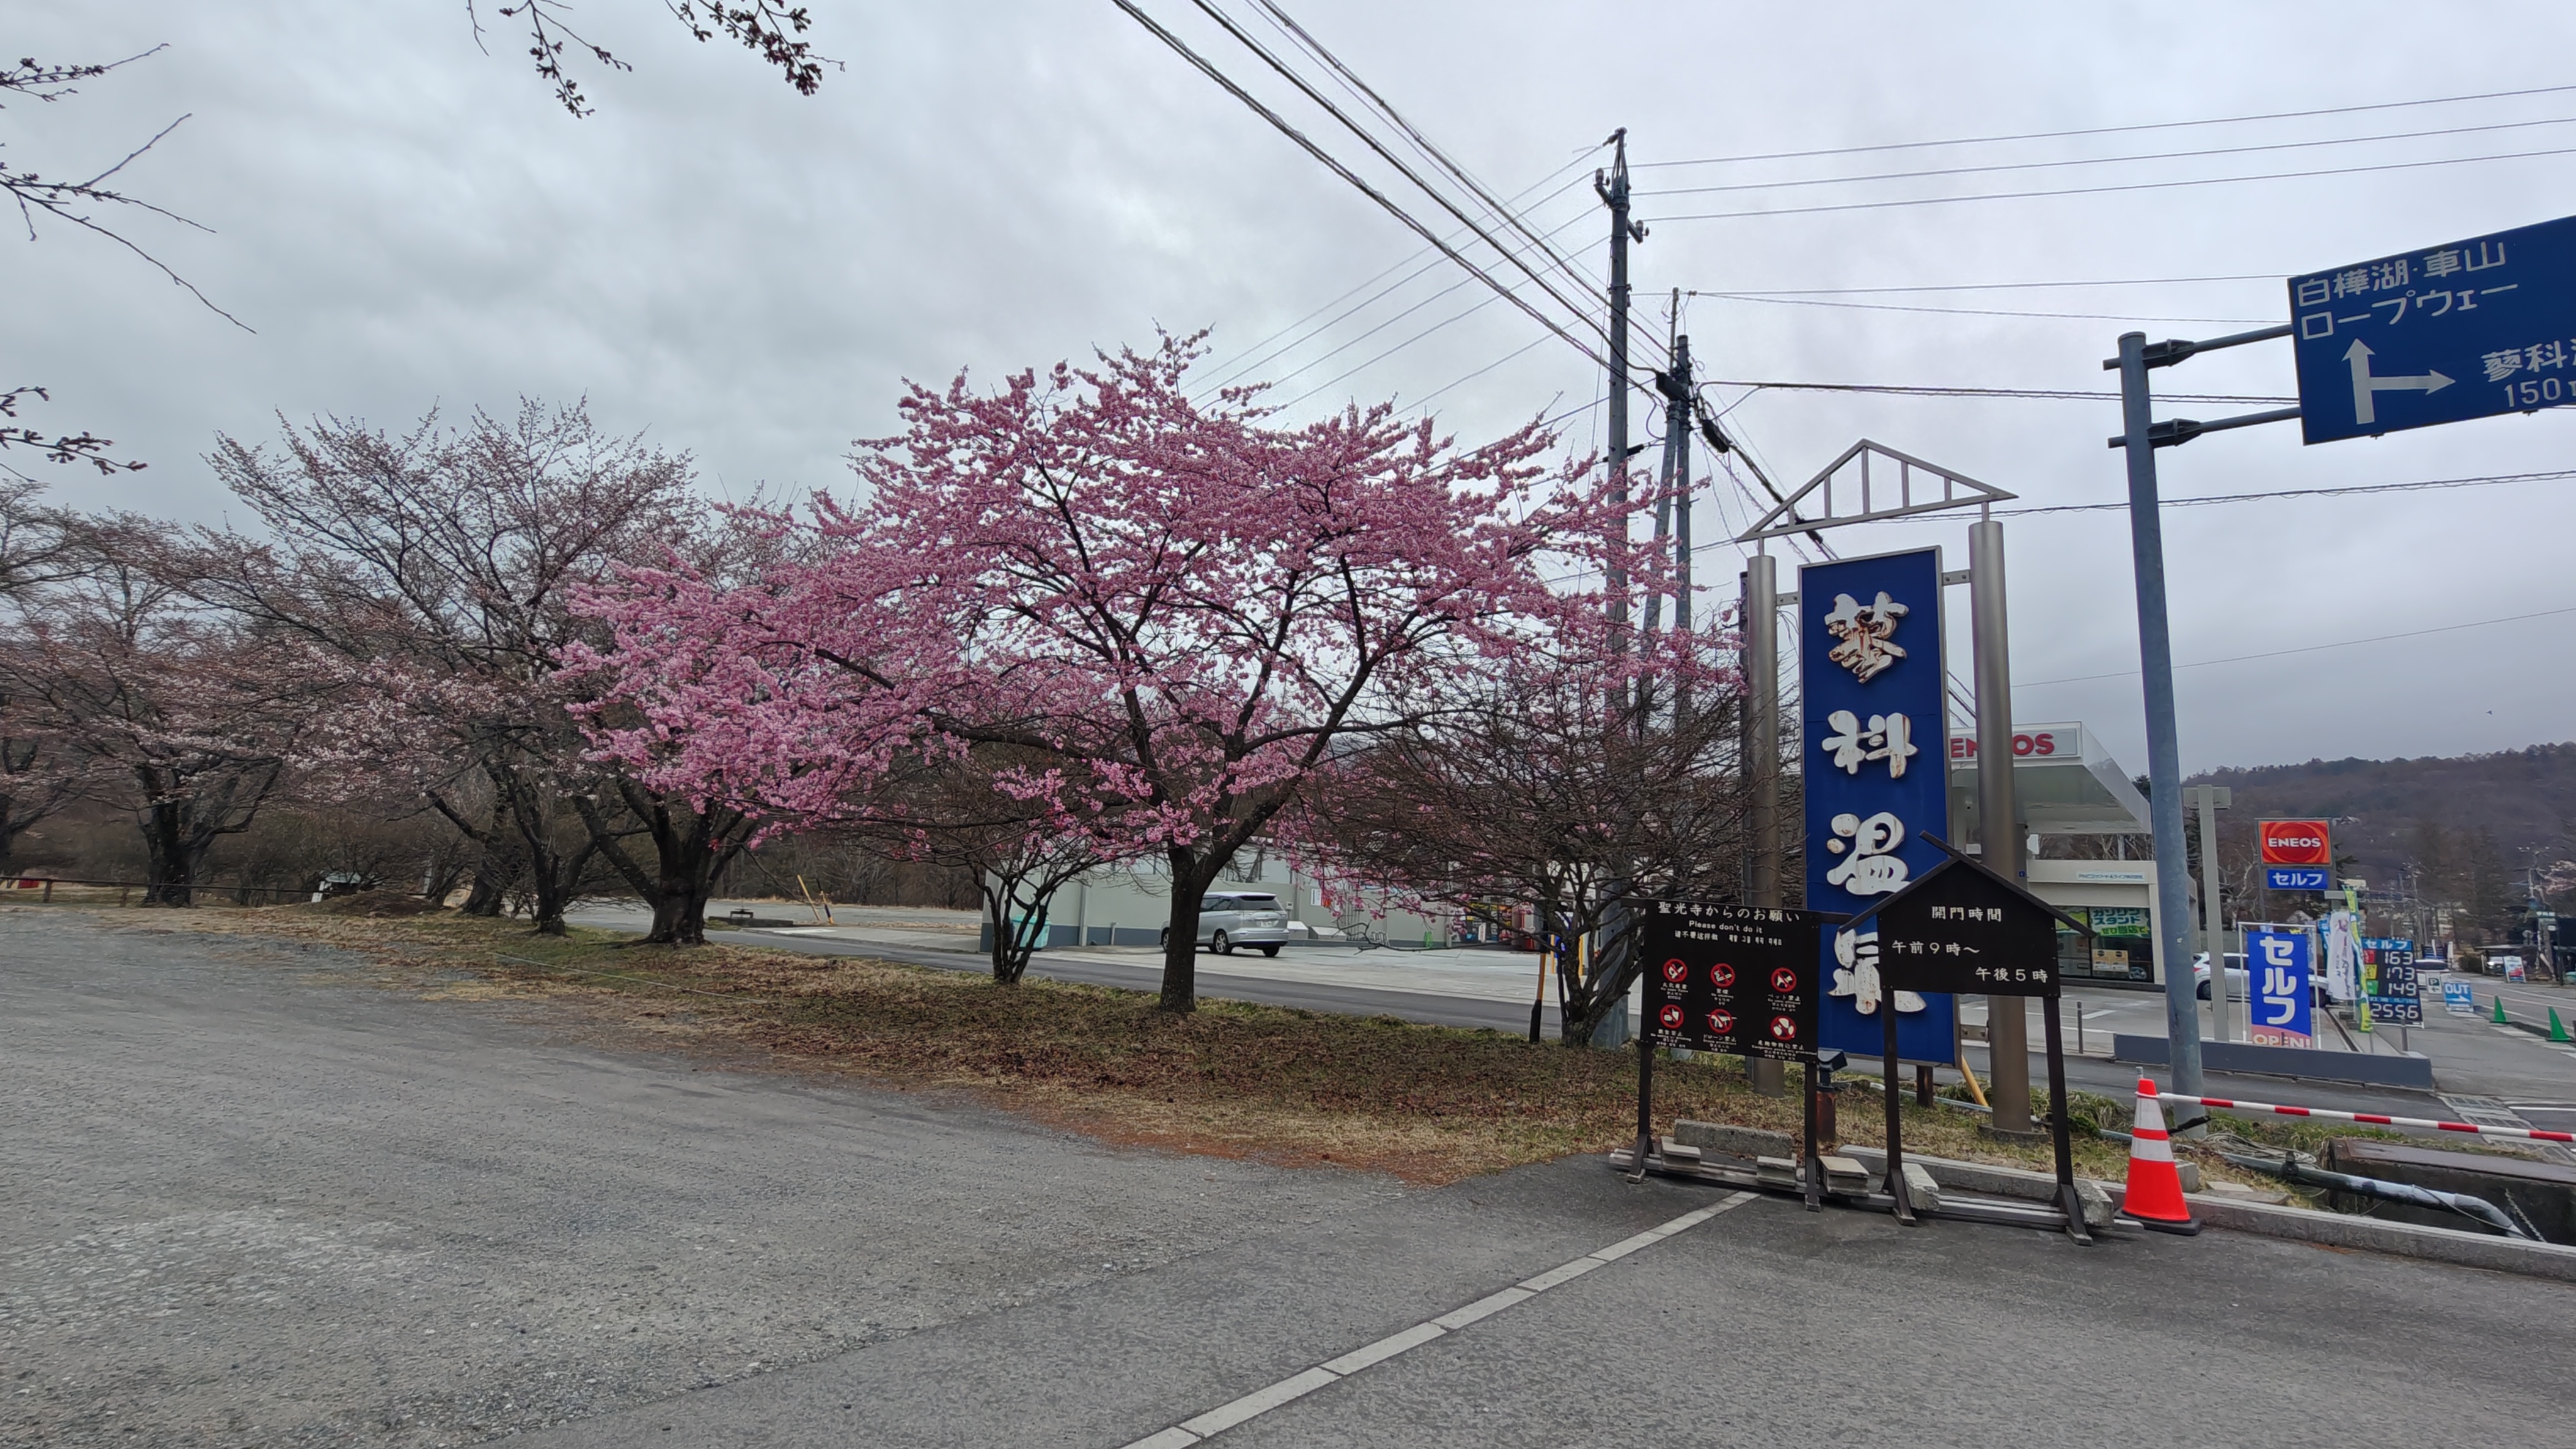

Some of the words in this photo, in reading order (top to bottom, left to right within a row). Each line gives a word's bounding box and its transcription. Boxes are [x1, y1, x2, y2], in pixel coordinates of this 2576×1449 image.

[2301, 284, 2518, 340] ロープウェー
[2480, 338, 2576, 382] 蓼科
[1951, 733, 2055, 758] ENOS
[2268, 837, 2321, 848] ENEOS
[2272, 872, 2323, 886] セルフ
[1658, 901, 1800, 922] 聖光寺からのお願い
[1931, 906, 2001, 921] 開門時間
[1689, 920, 1716, 930] Please
[1719, 923, 1740, 931] don't
[2094, 916, 2141, 925] スタンド
[2365, 939, 2408, 949] セルフ
[2385, 952, 2413, 965] 163
[2259, 936, 2297, 1024] セルフ
[2387, 967, 2415, 980] 173
[2389, 982, 2417, 996] 149
[2445, 984, 2468, 994] OUT
[2370, 1003, 2418, 1019] 2556
